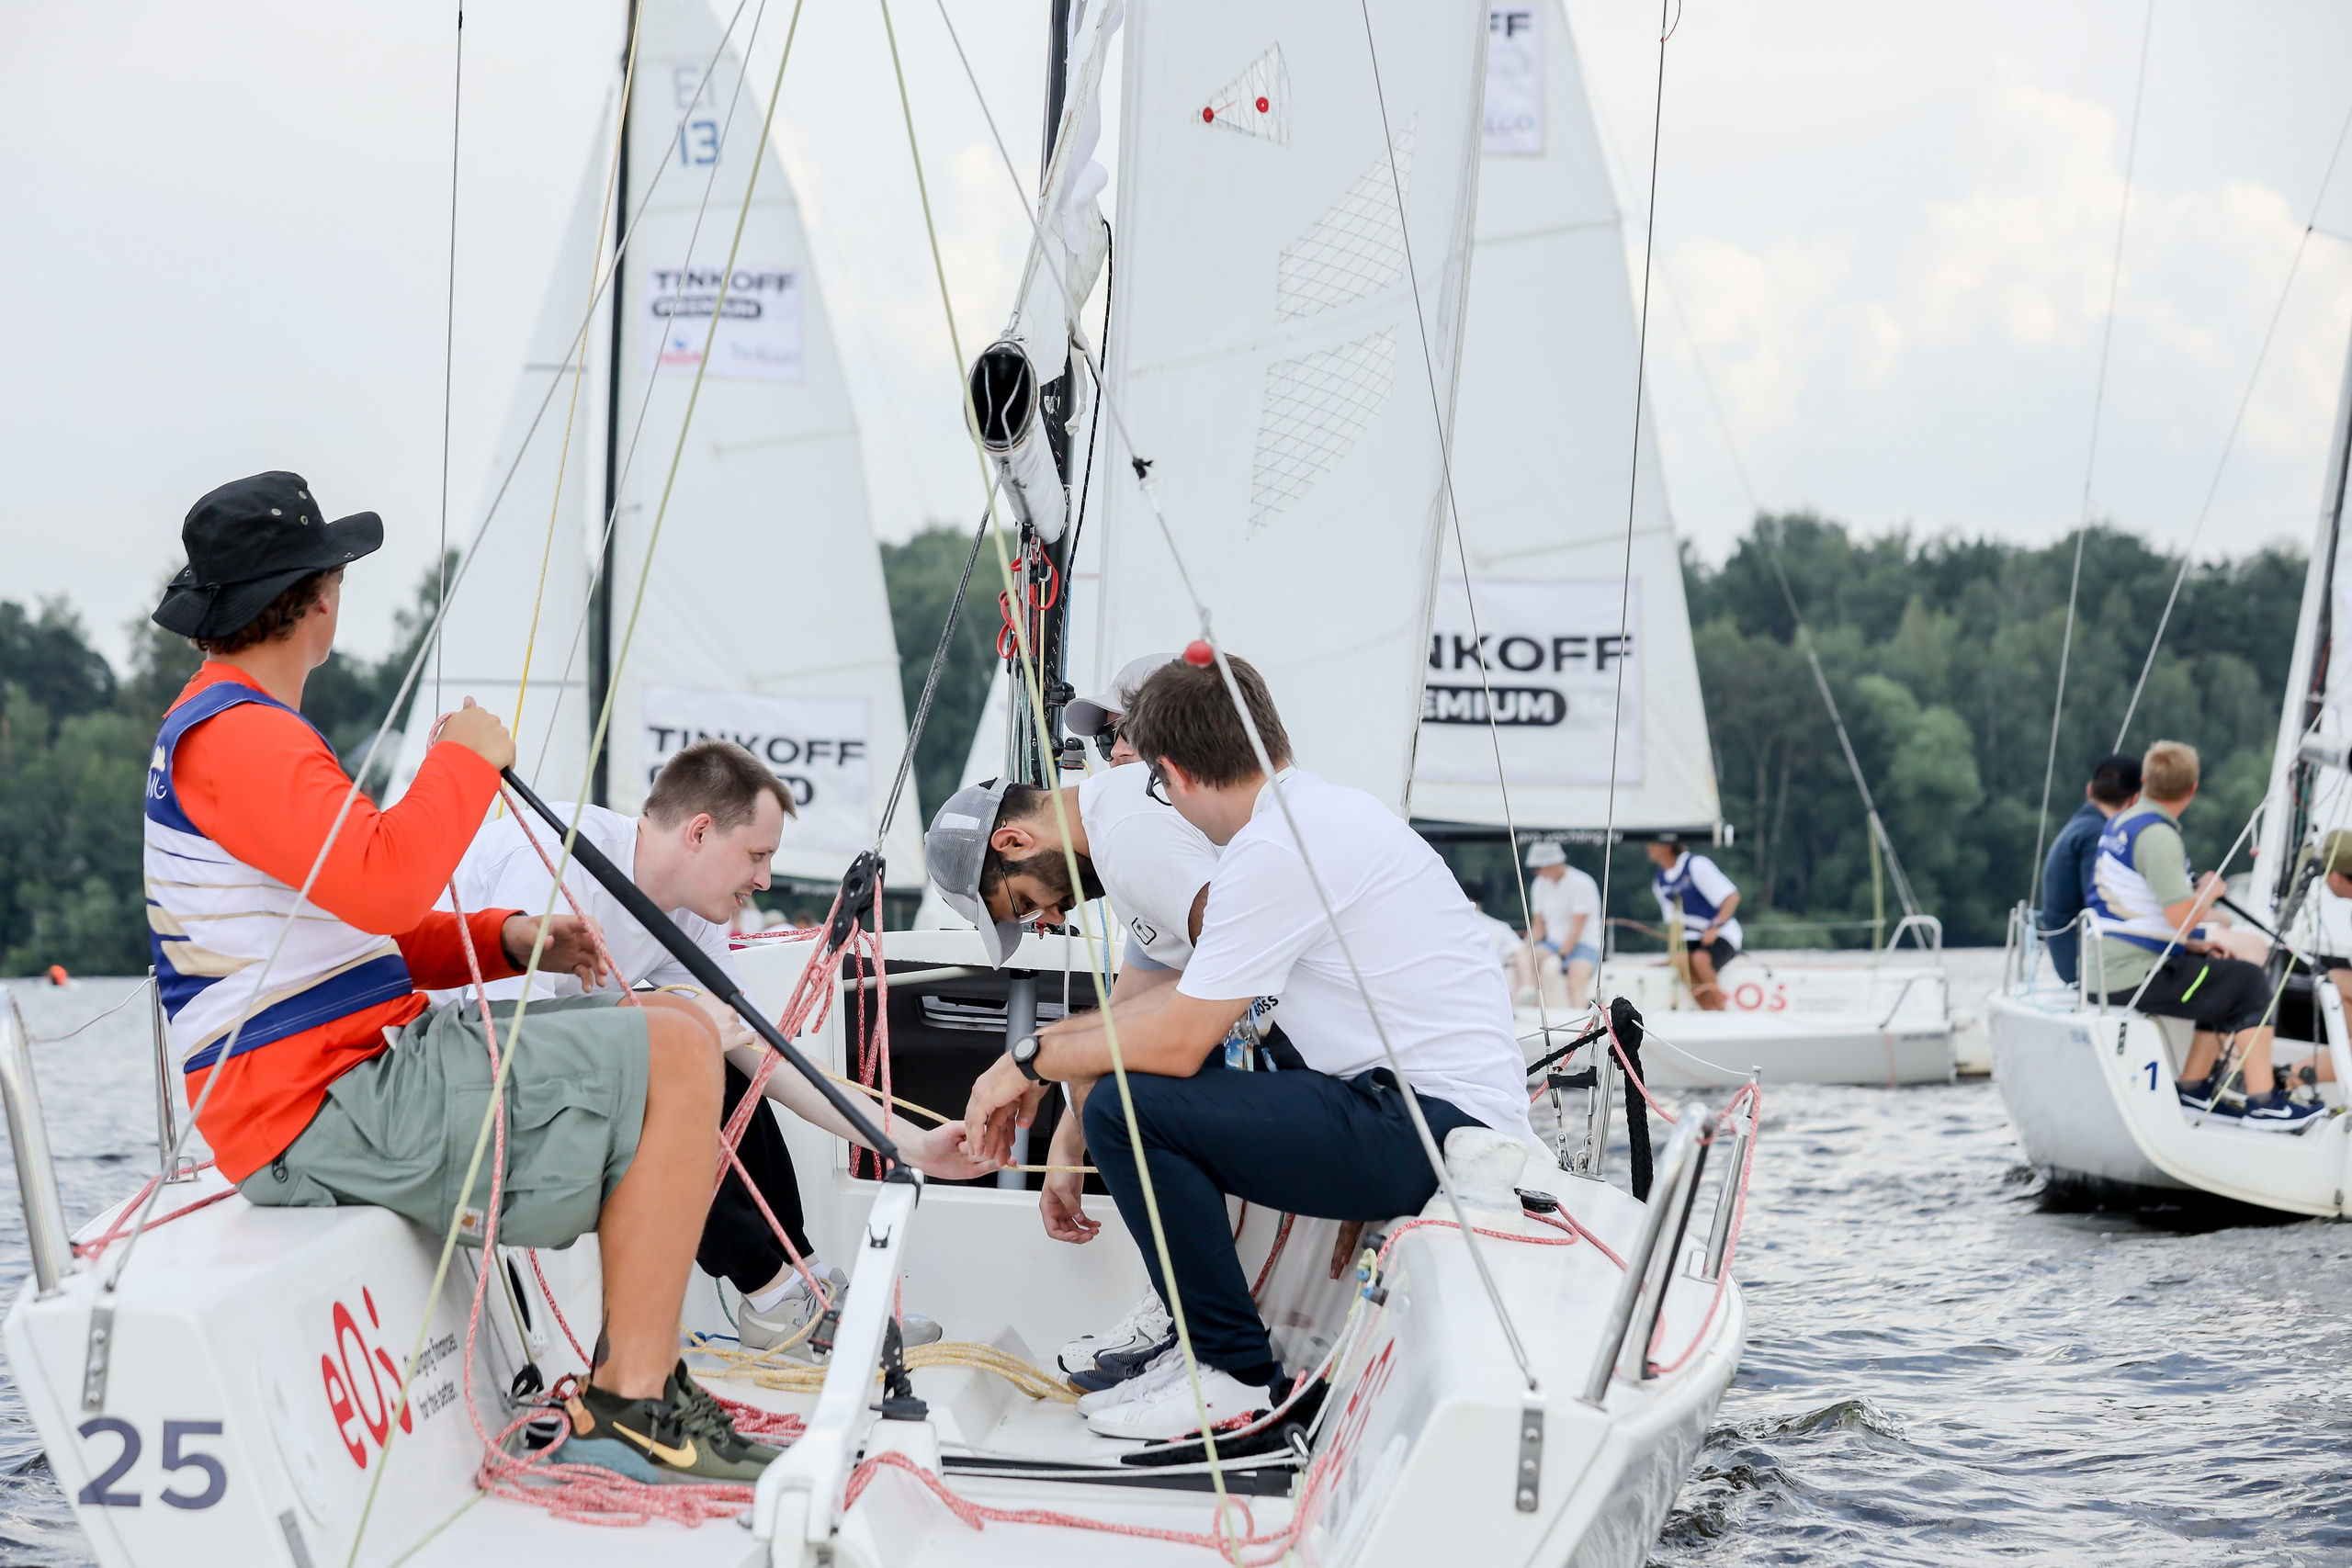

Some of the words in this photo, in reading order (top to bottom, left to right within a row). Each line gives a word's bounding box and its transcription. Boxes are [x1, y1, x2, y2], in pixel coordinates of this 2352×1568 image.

[679, 120, 720, 165] 13
[649, 727, 865, 765] TIKOFF
[2143, 1061, 2158, 1091] 1
[77, 1416, 227, 1510] 25
